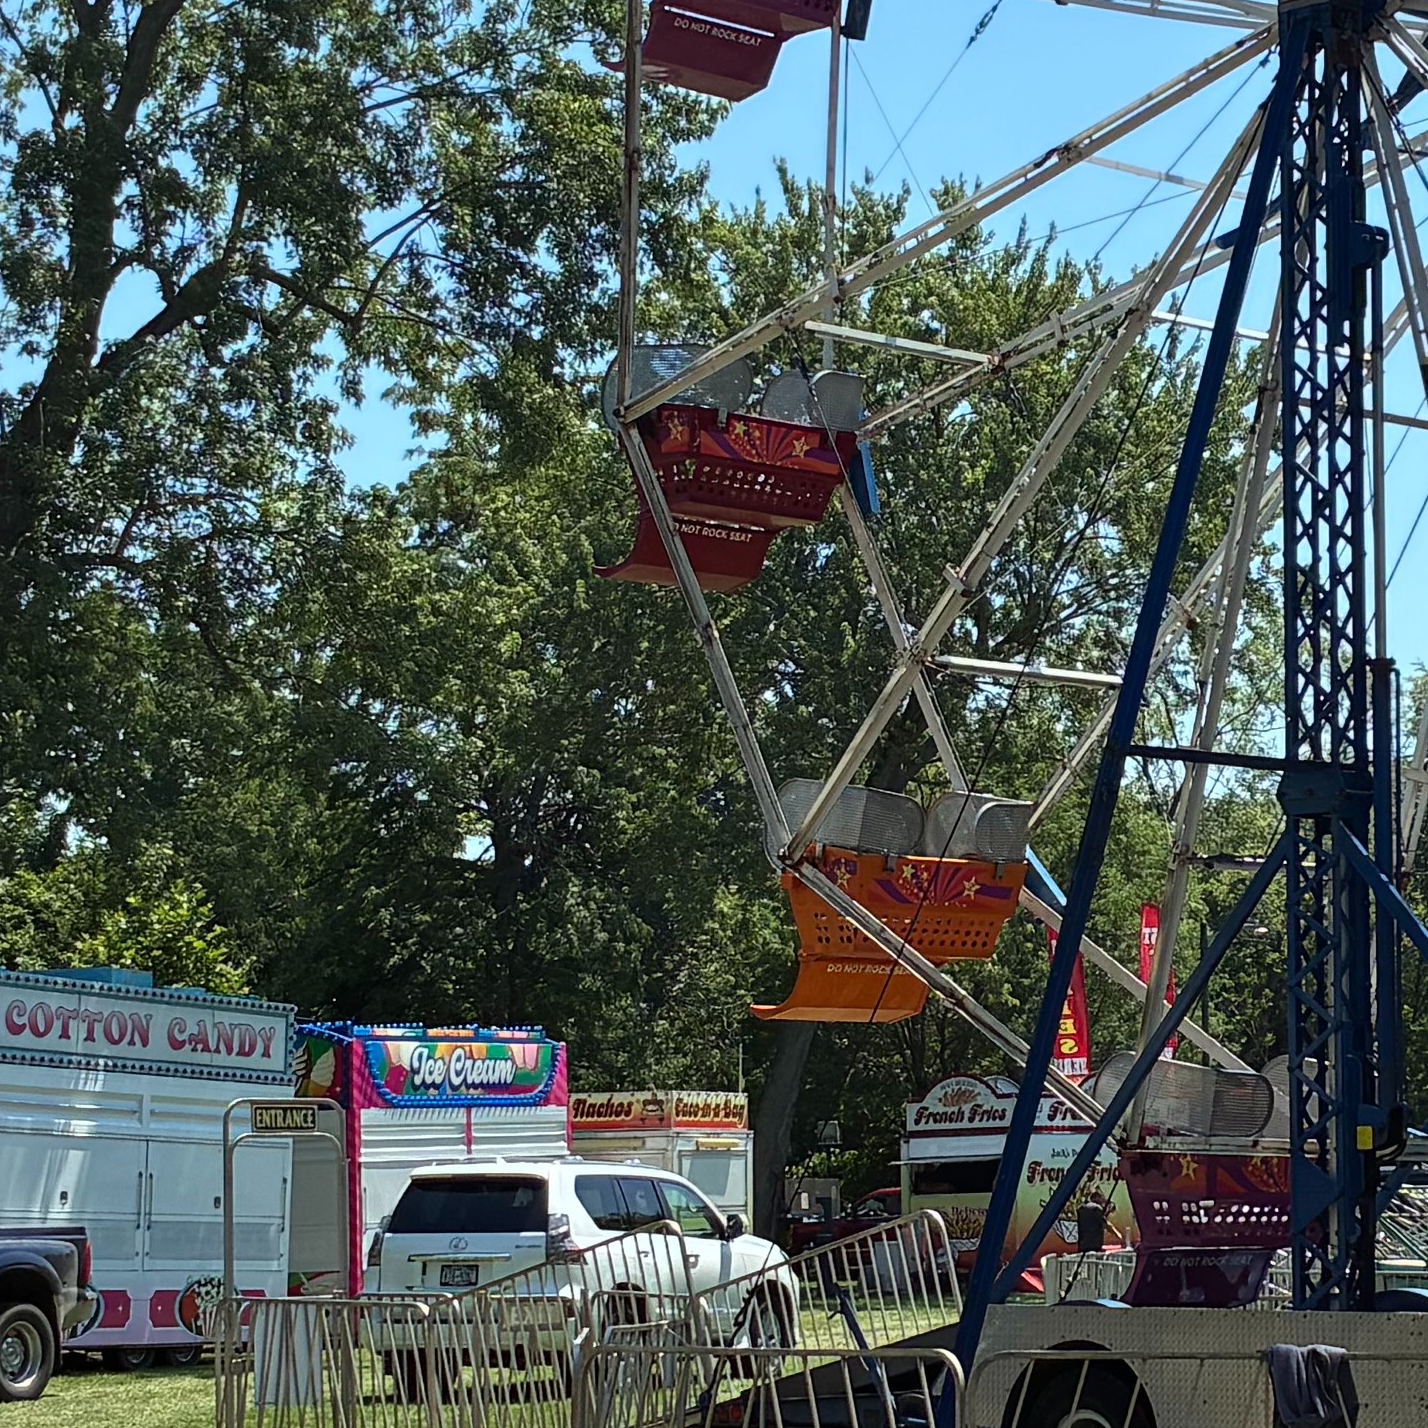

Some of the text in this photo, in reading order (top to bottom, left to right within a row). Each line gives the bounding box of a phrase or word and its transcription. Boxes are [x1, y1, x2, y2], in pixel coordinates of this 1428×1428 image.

[674, 17, 762, 46] DO NOT ROCK SEAT
[680, 524, 702, 535] NOT
[702, 526, 729, 539] ROCK
[729, 531, 752, 543] SEAT
[826, 963, 844, 973] DO
[843, 964, 865, 974] NOT
[4, 997, 277, 1060] COTTON CANDY
[411, 1045, 517, 1087] Ice Cream
[256, 1109, 315, 1128] ENTRANCE
[572, 1096, 635, 1120] Nachos
[913, 1103, 1007, 1126] French Fries
[1026, 1160, 1070, 1186] Fren
